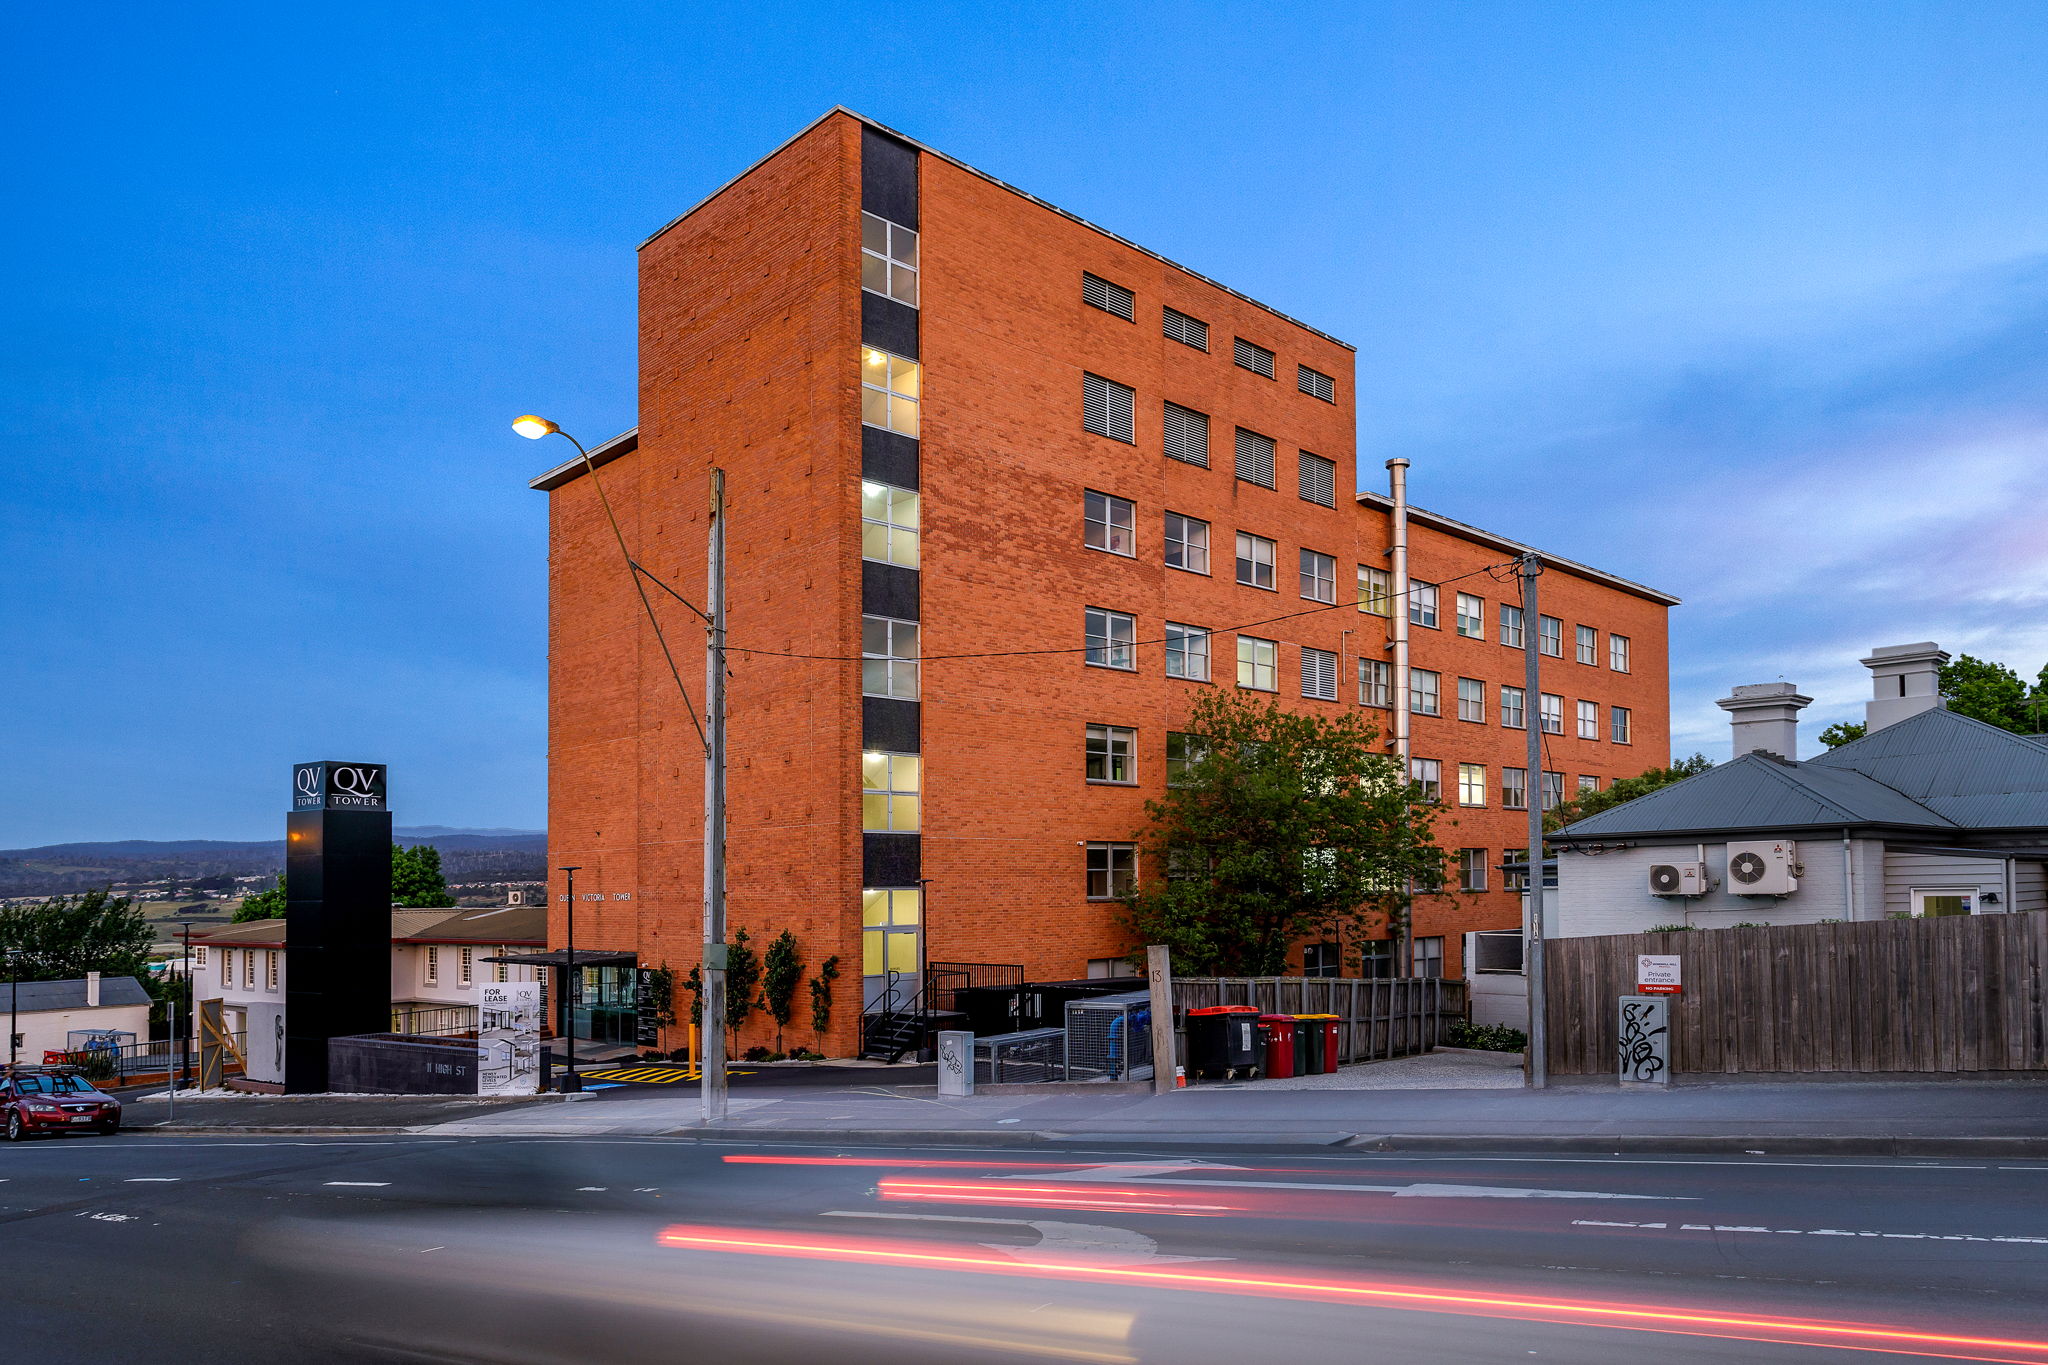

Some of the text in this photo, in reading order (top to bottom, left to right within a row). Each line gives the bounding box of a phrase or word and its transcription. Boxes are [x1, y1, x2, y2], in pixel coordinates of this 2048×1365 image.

[297, 767, 321, 797] QV
[333, 767, 379, 797] QV
[297, 797, 321, 806] TOWER
[333, 797, 378, 806] TOWER
[582, 893, 605, 902] VICTORIA
[613, 892, 631, 901] TOWER
[1152, 970, 1162, 982] 13
[520, 990, 532, 999] QV
[435, 1063, 452, 1075] HIGH
[456, 1065, 466, 1076] ST
